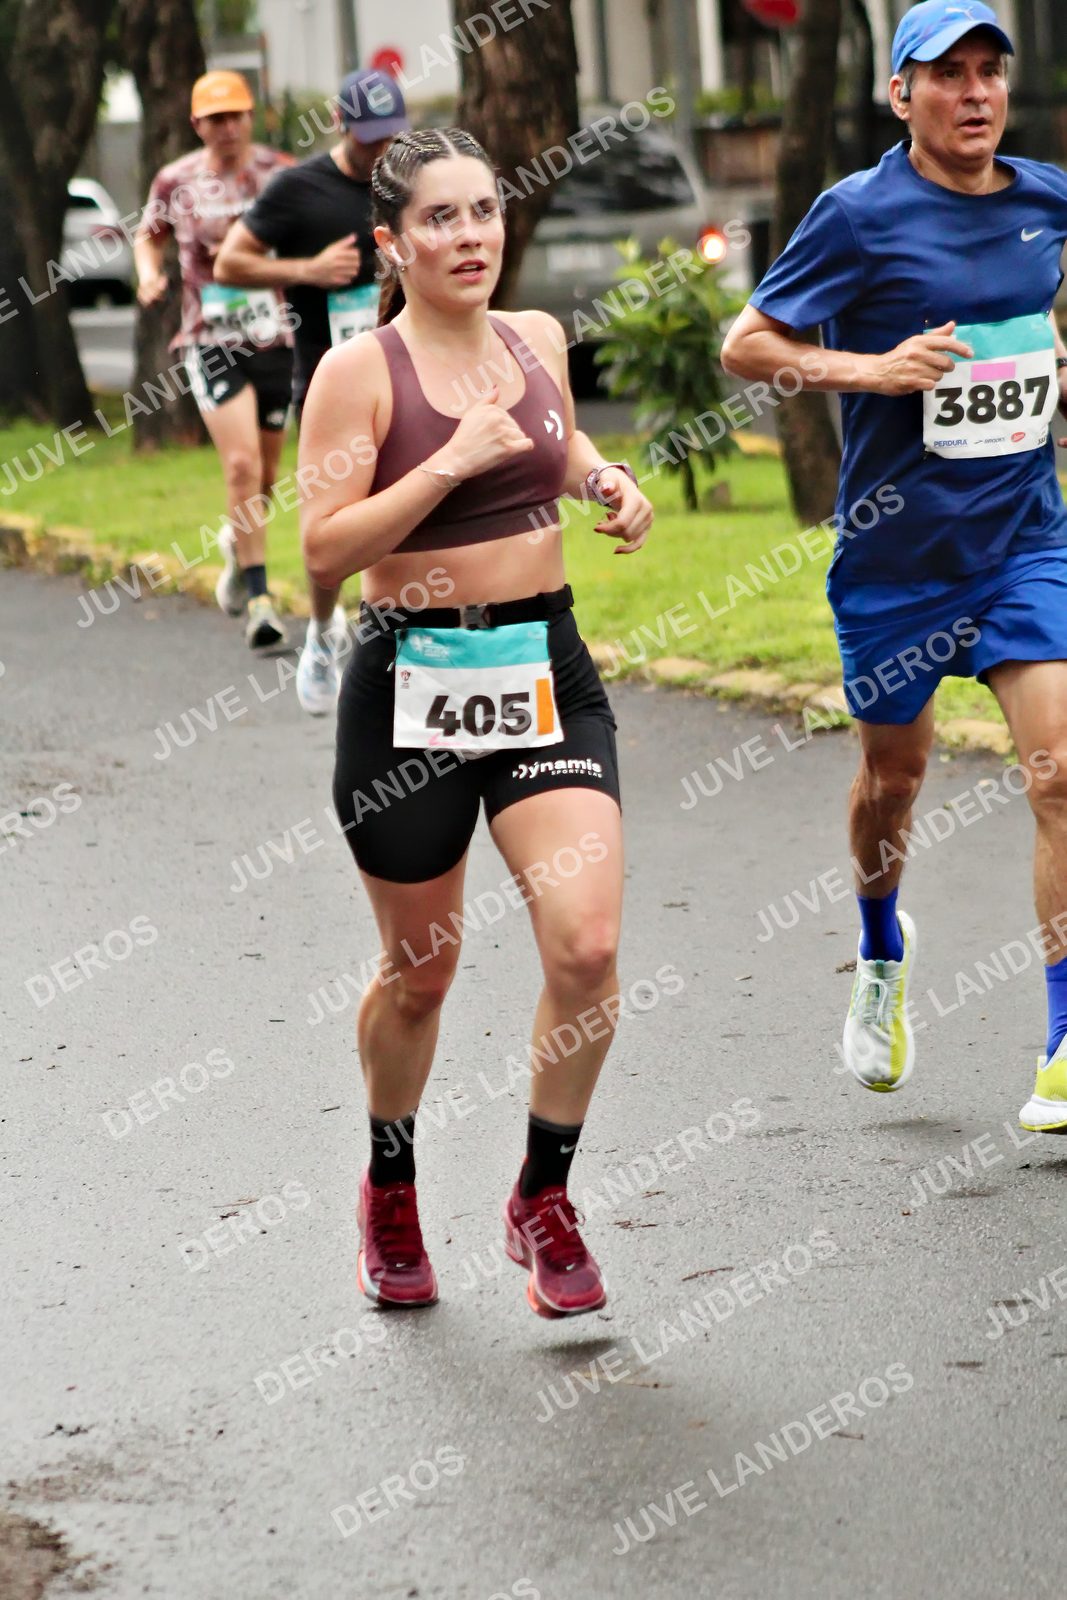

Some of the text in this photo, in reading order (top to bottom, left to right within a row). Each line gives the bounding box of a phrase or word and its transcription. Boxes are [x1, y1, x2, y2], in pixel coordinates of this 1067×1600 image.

[933, 375, 1050, 427] 3887
[933, 439, 968, 447] PERDURA
[426, 692, 532, 737] 405
